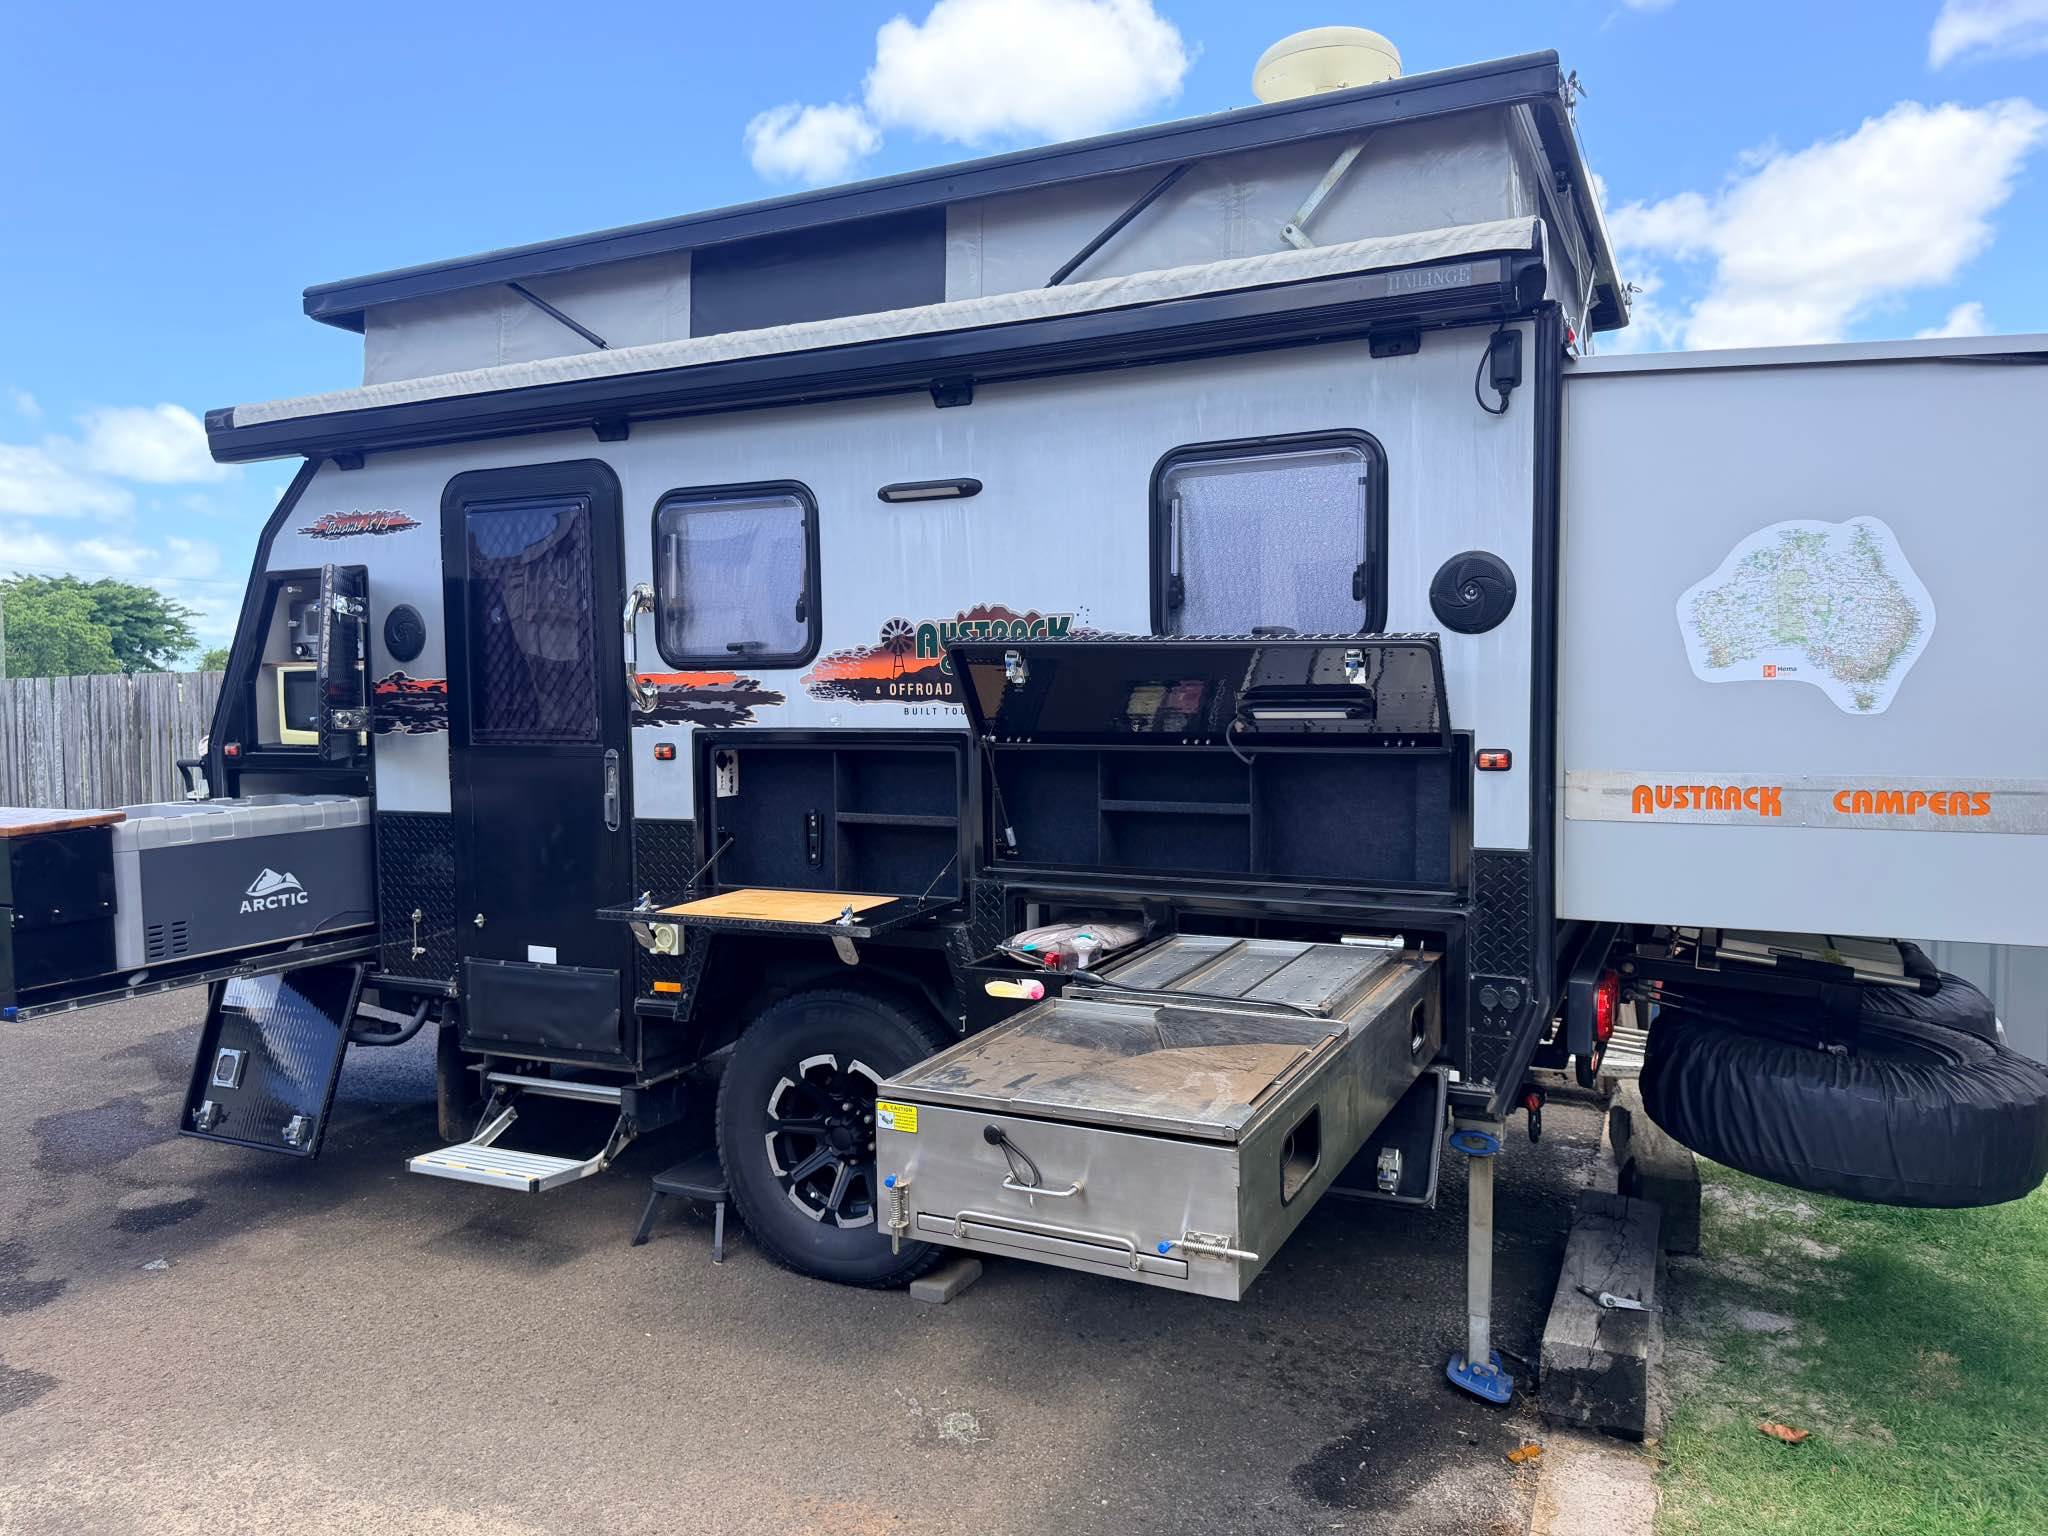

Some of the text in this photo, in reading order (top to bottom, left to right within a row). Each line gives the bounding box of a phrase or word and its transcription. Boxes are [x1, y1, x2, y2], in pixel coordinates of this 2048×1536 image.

[889, 682, 953, 696] OFFROAD
[903, 707, 966, 716] BUILT TOU
[1631, 784, 1991, 817] AUSTRACK CAMPERS
[239, 891, 309, 914] ARCTIC
[889, 1104, 913, 1113] CAUTION
